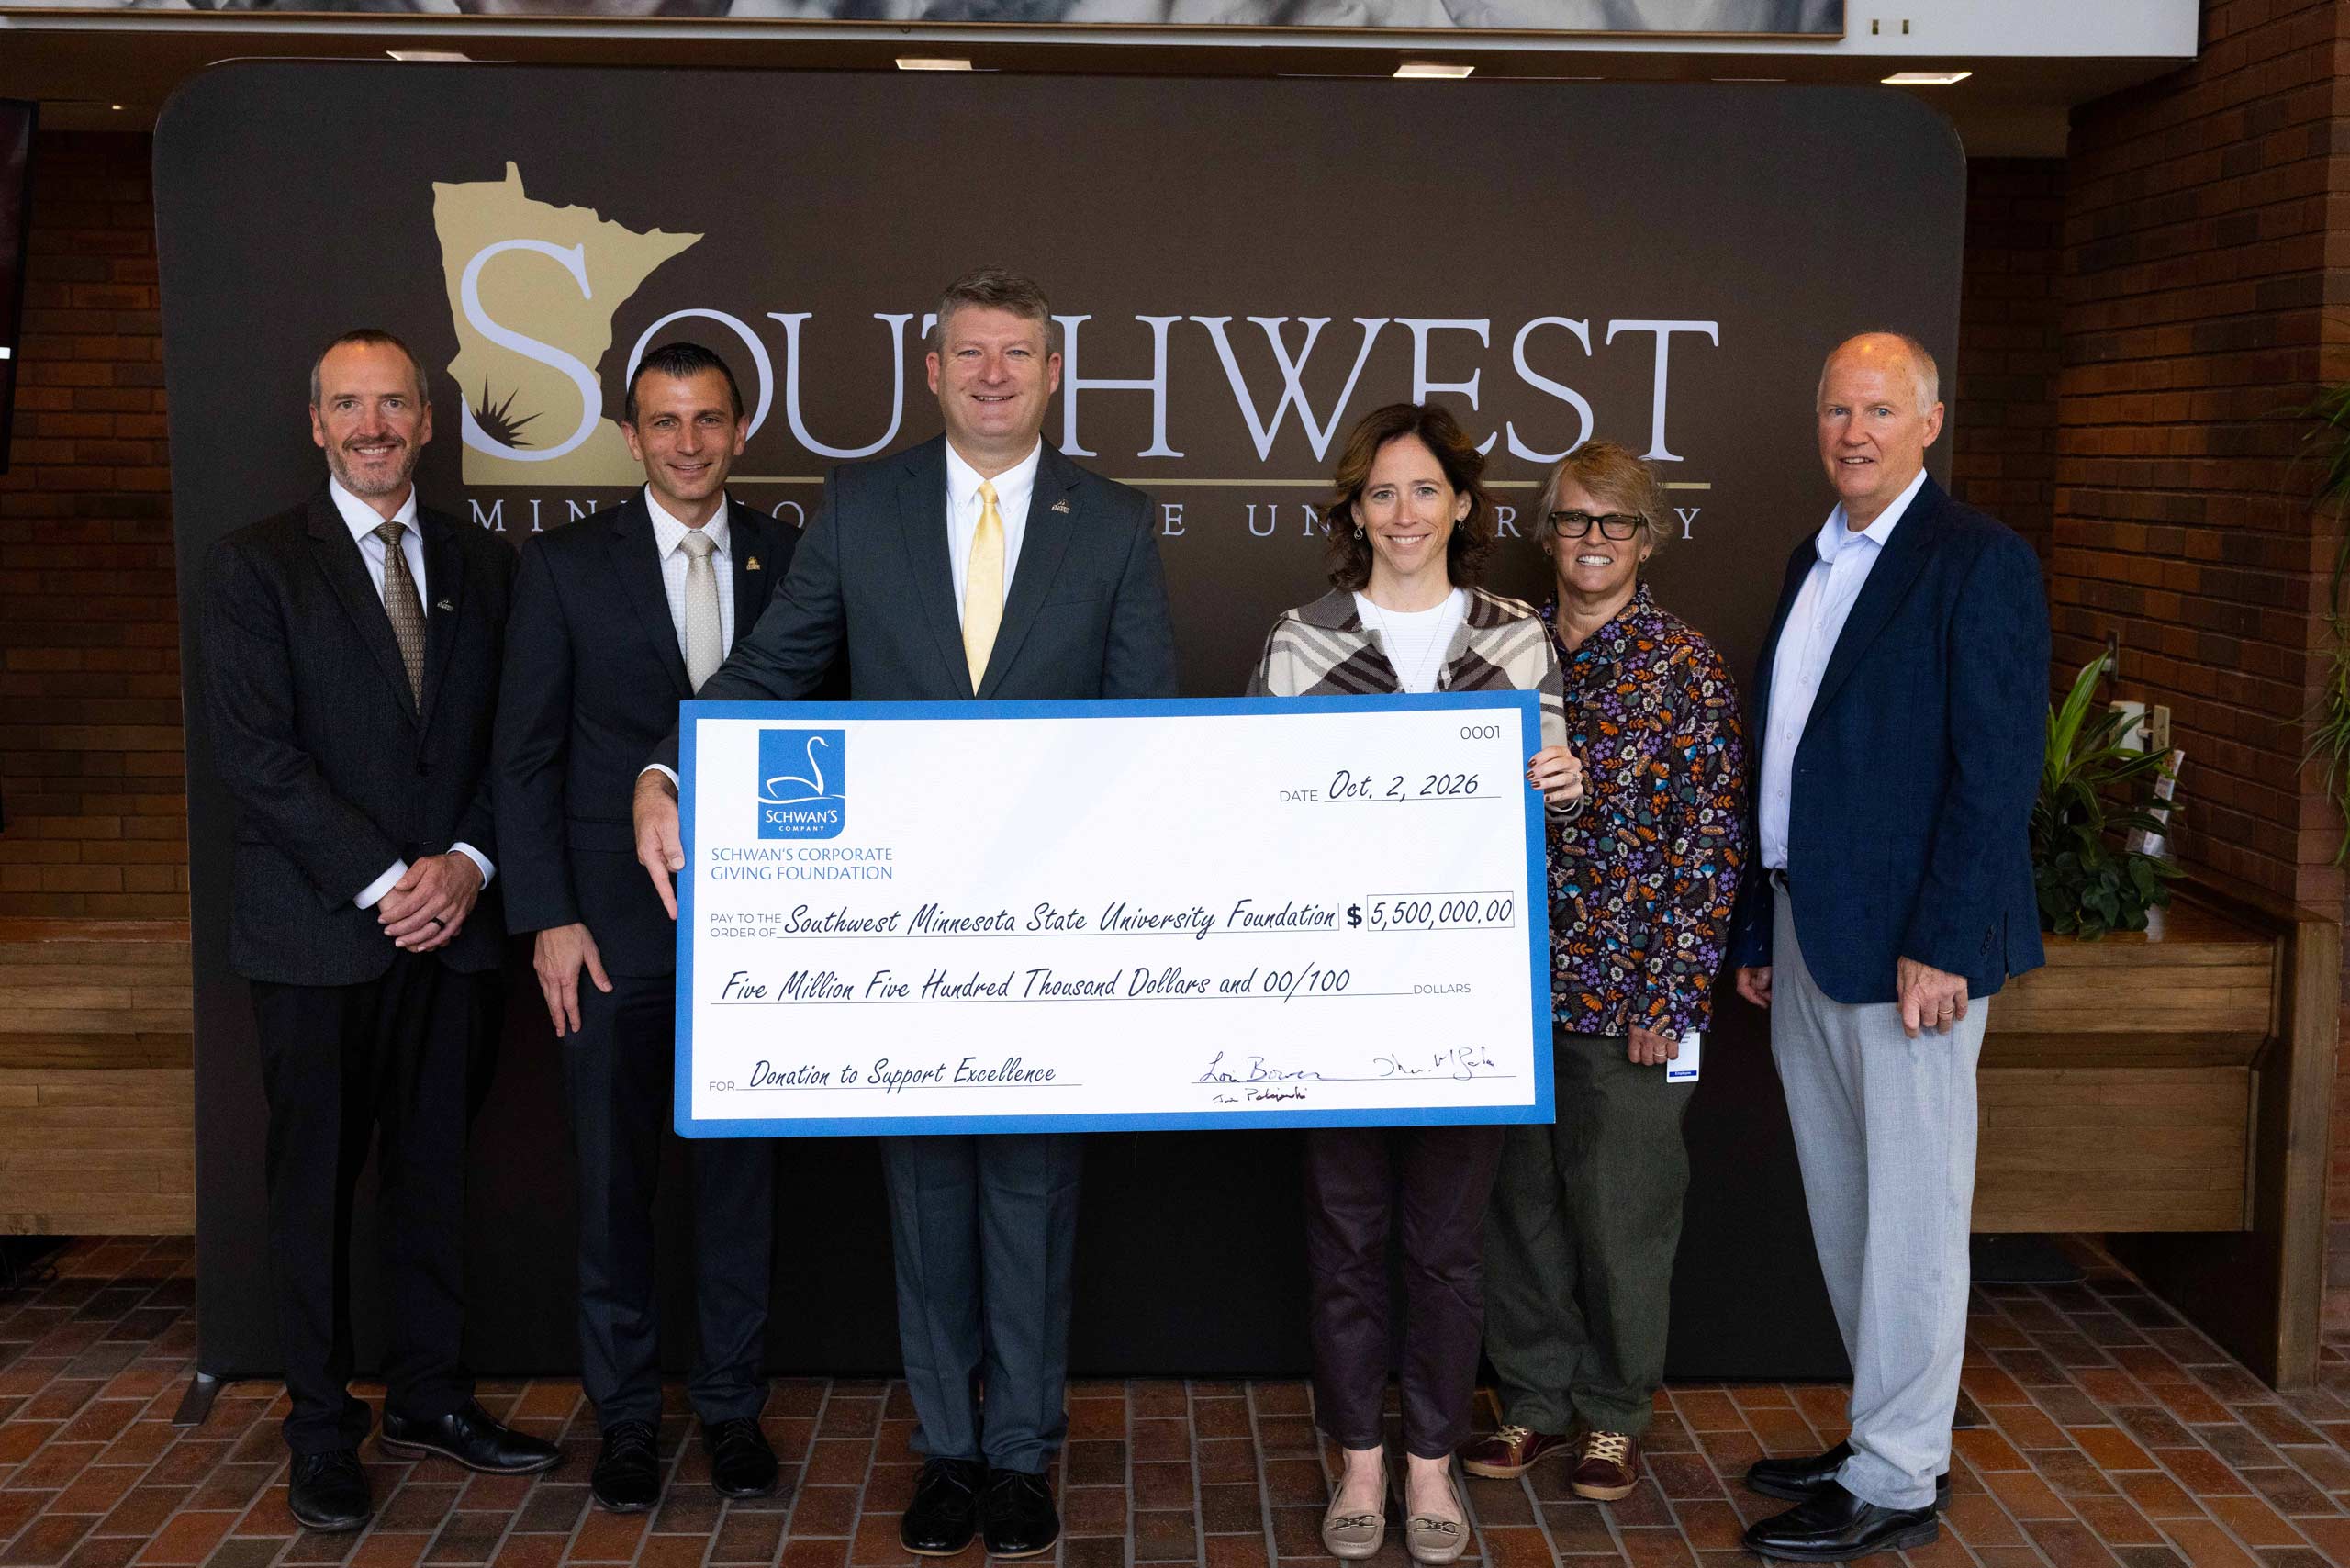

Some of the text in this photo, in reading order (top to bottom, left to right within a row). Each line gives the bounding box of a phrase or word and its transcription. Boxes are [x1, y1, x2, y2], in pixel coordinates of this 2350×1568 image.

[460, 239, 1719, 463] SOUHWEST
[1460, 725, 1500, 740] 0001
[1329, 769, 1478, 803] Oct. 2, 2026
[1280, 790, 1319, 802] DATE
[766, 809, 838, 823] SCHWAN'S
[711, 847, 892, 861] SCHWAN'S CORPORATE
[711, 866, 892, 880] GIVING FOUNDATION
[711, 913, 782, 924] PAY TO THE
[784, 898, 1336, 941] Southwest Minnesota State University Foundation
[1347, 899, 1513, 931] $ 5,500,000.00
[710, 927, 777, 938] ORDER OF
[722, 961, 1350, 1003] Five Million Five Hundred Thousand Dollars and 00/100
[1413, 983, 1472, 995] DOLLARS
[749, 1057, 1056, 1094] Donation to Support Excellence
[709, 1081, 735, 1092] FOR
